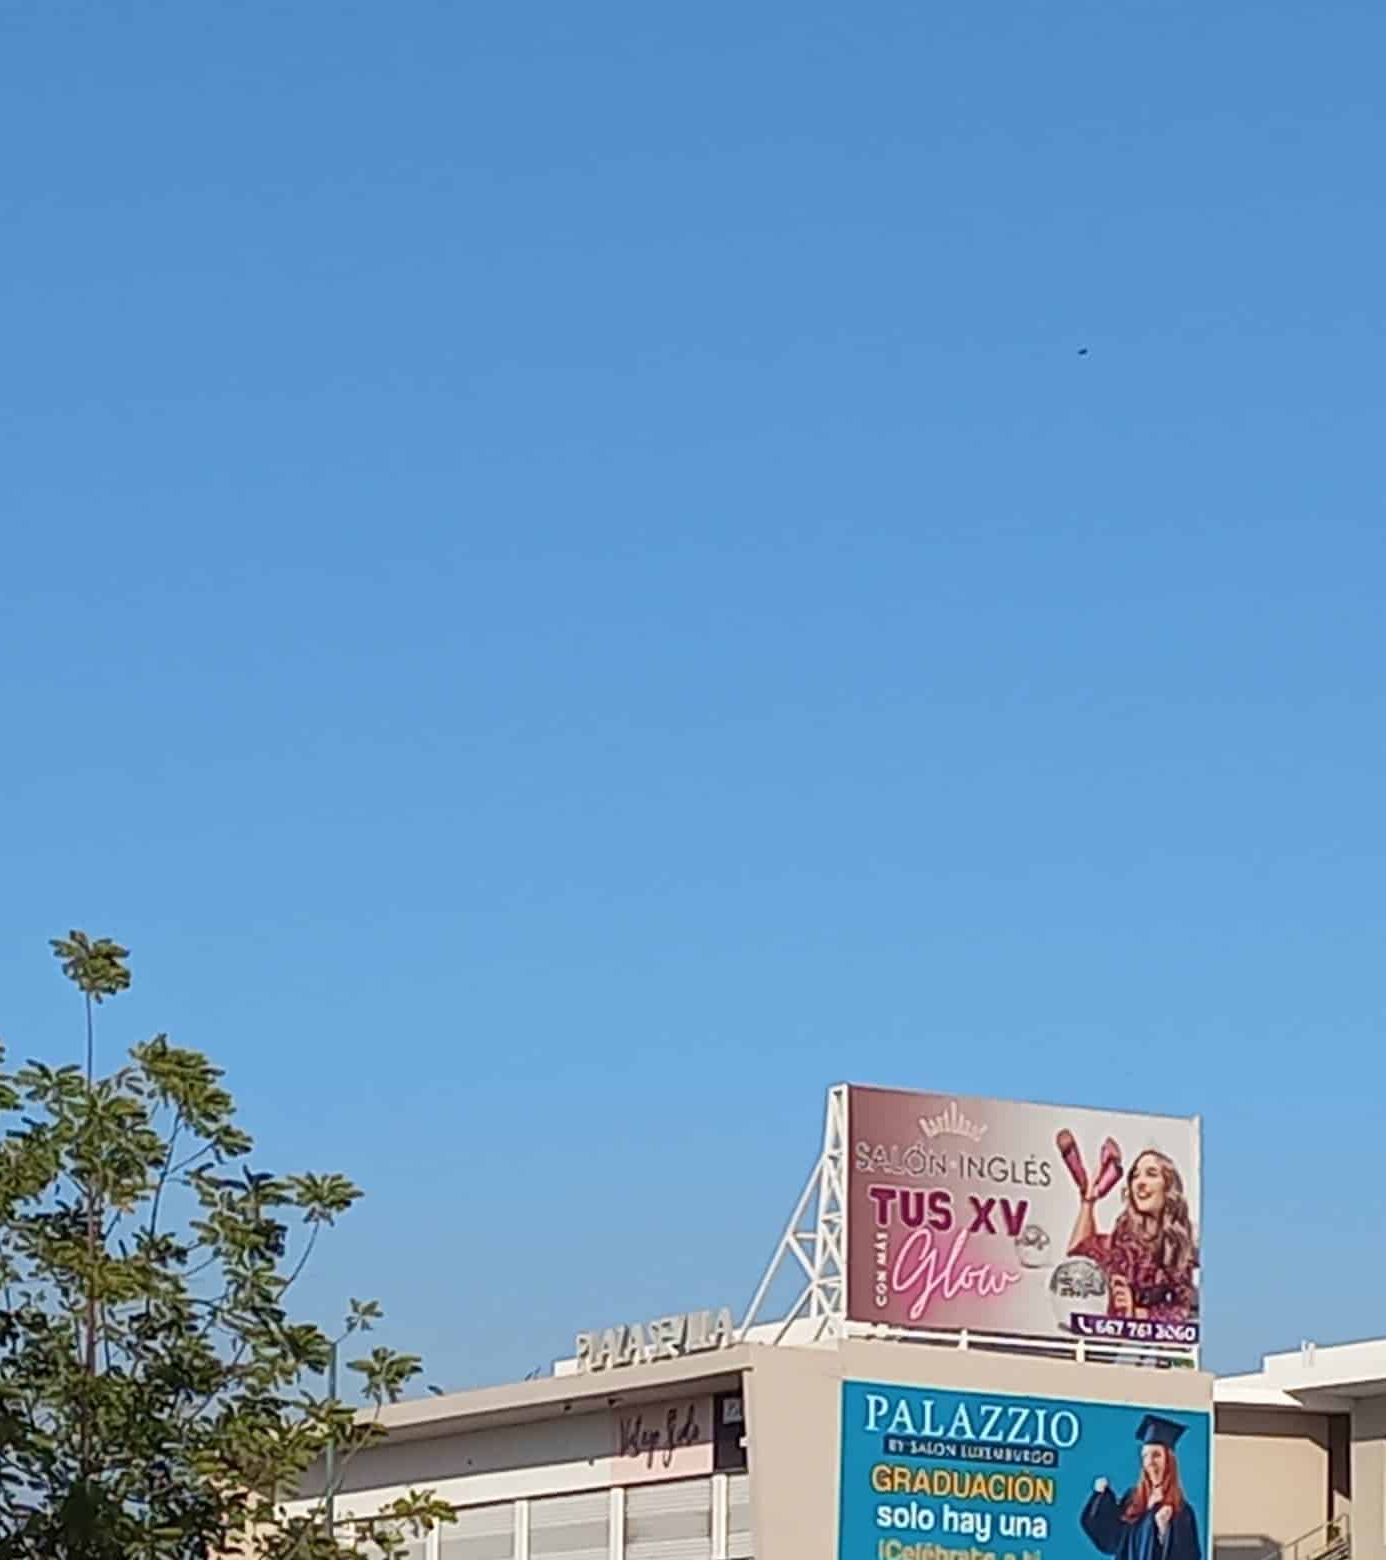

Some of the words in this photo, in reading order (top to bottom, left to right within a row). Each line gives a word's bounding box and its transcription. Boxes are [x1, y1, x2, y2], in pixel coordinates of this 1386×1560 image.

[856, 1139, 947, 1175] SALÓN
[959, 1153, 1052, 1187] INGLÉS
[870, 1187, 953, 1231] TUS
[969, 1195, 1029, 1237] XV
[892, 1227, 1021, 1320] Glow
[864, 1393, 1080, 1448] PALAZZIO
[871, 1463, 1054, 1504] GRADUACIÓN
[876, 1501, 935, 1531] solo
[942, 1503, 992, 1542] hay
[999, 1512, 1048, 1538] una
